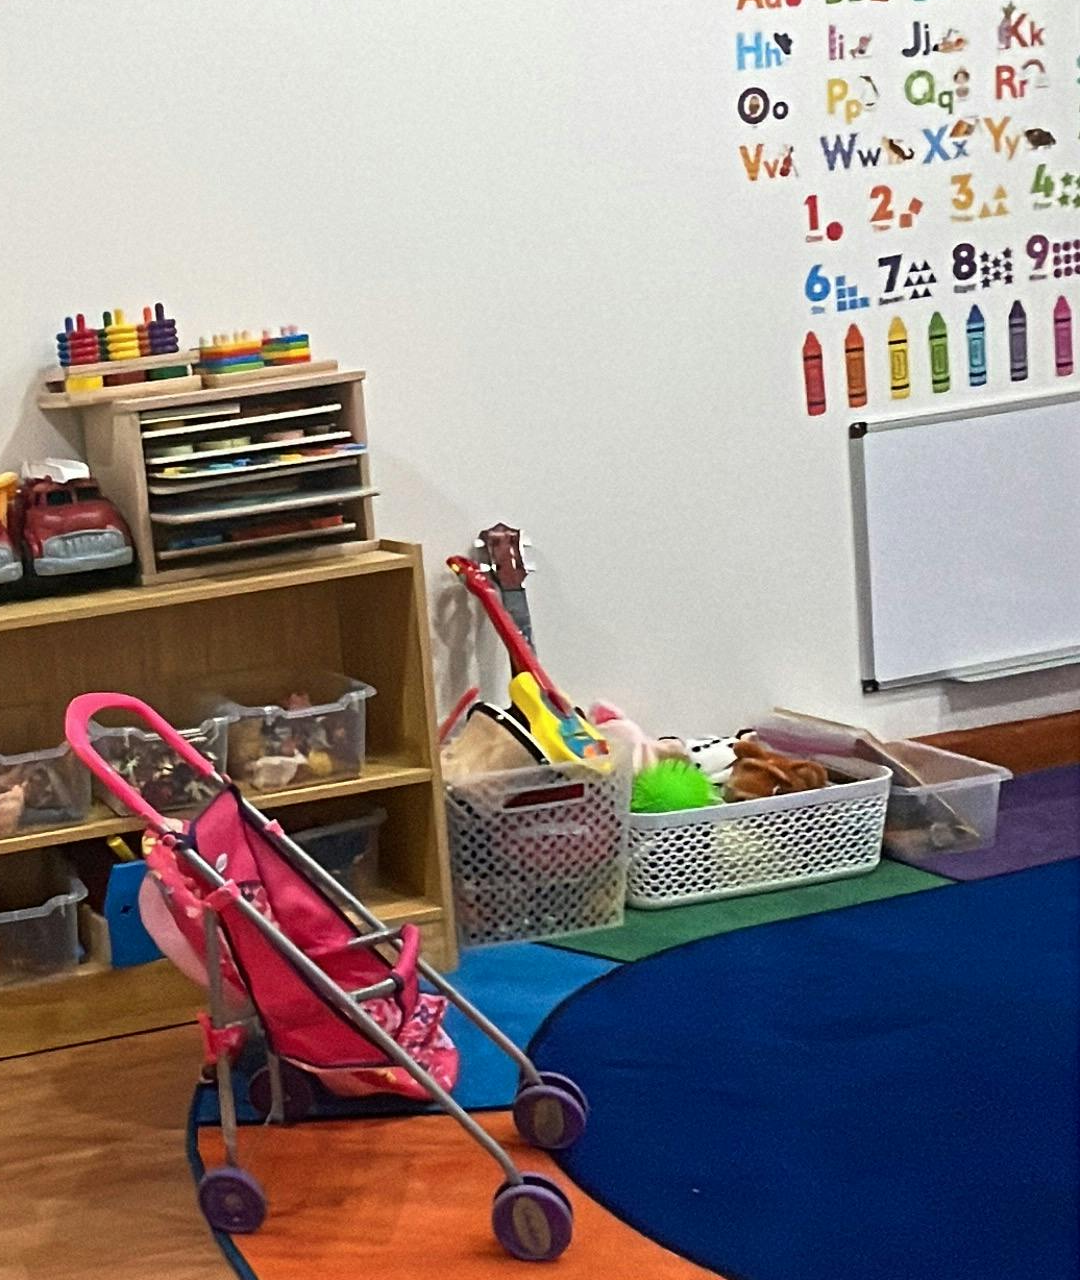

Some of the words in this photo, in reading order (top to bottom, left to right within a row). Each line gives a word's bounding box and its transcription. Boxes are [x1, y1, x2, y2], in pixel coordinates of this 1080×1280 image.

[736, 31, 782, 70] Hh
[828, 24, 844, 61] Ii
[901, 21, 931, 57] Jj
[1000, 13, 1045, 48] Kk
[737, 87, 789, 124] Oo
[827, 78, 863, 124] Pp
[904, 69, 954, 114] Qq
[995, 65, 1029, 100] Rr
[739, 143, 780, 181] Vv
[820, 133, 882, 171] Ww
[922, 124, 968, 164] Xx
[983, 115, 1021, 160] Yy
[804, 195, 819, 231] 1
[869, 185, 894, 222] 2
[951, 173, 975, 210] 3
[1030, 163, 1055, 198] 4
[805, 264, 831, 302] 6
[878, 253, 903, 293] 7
[952, 243, 977, 280] 8
[1026, 234, 1049, 270] 9
